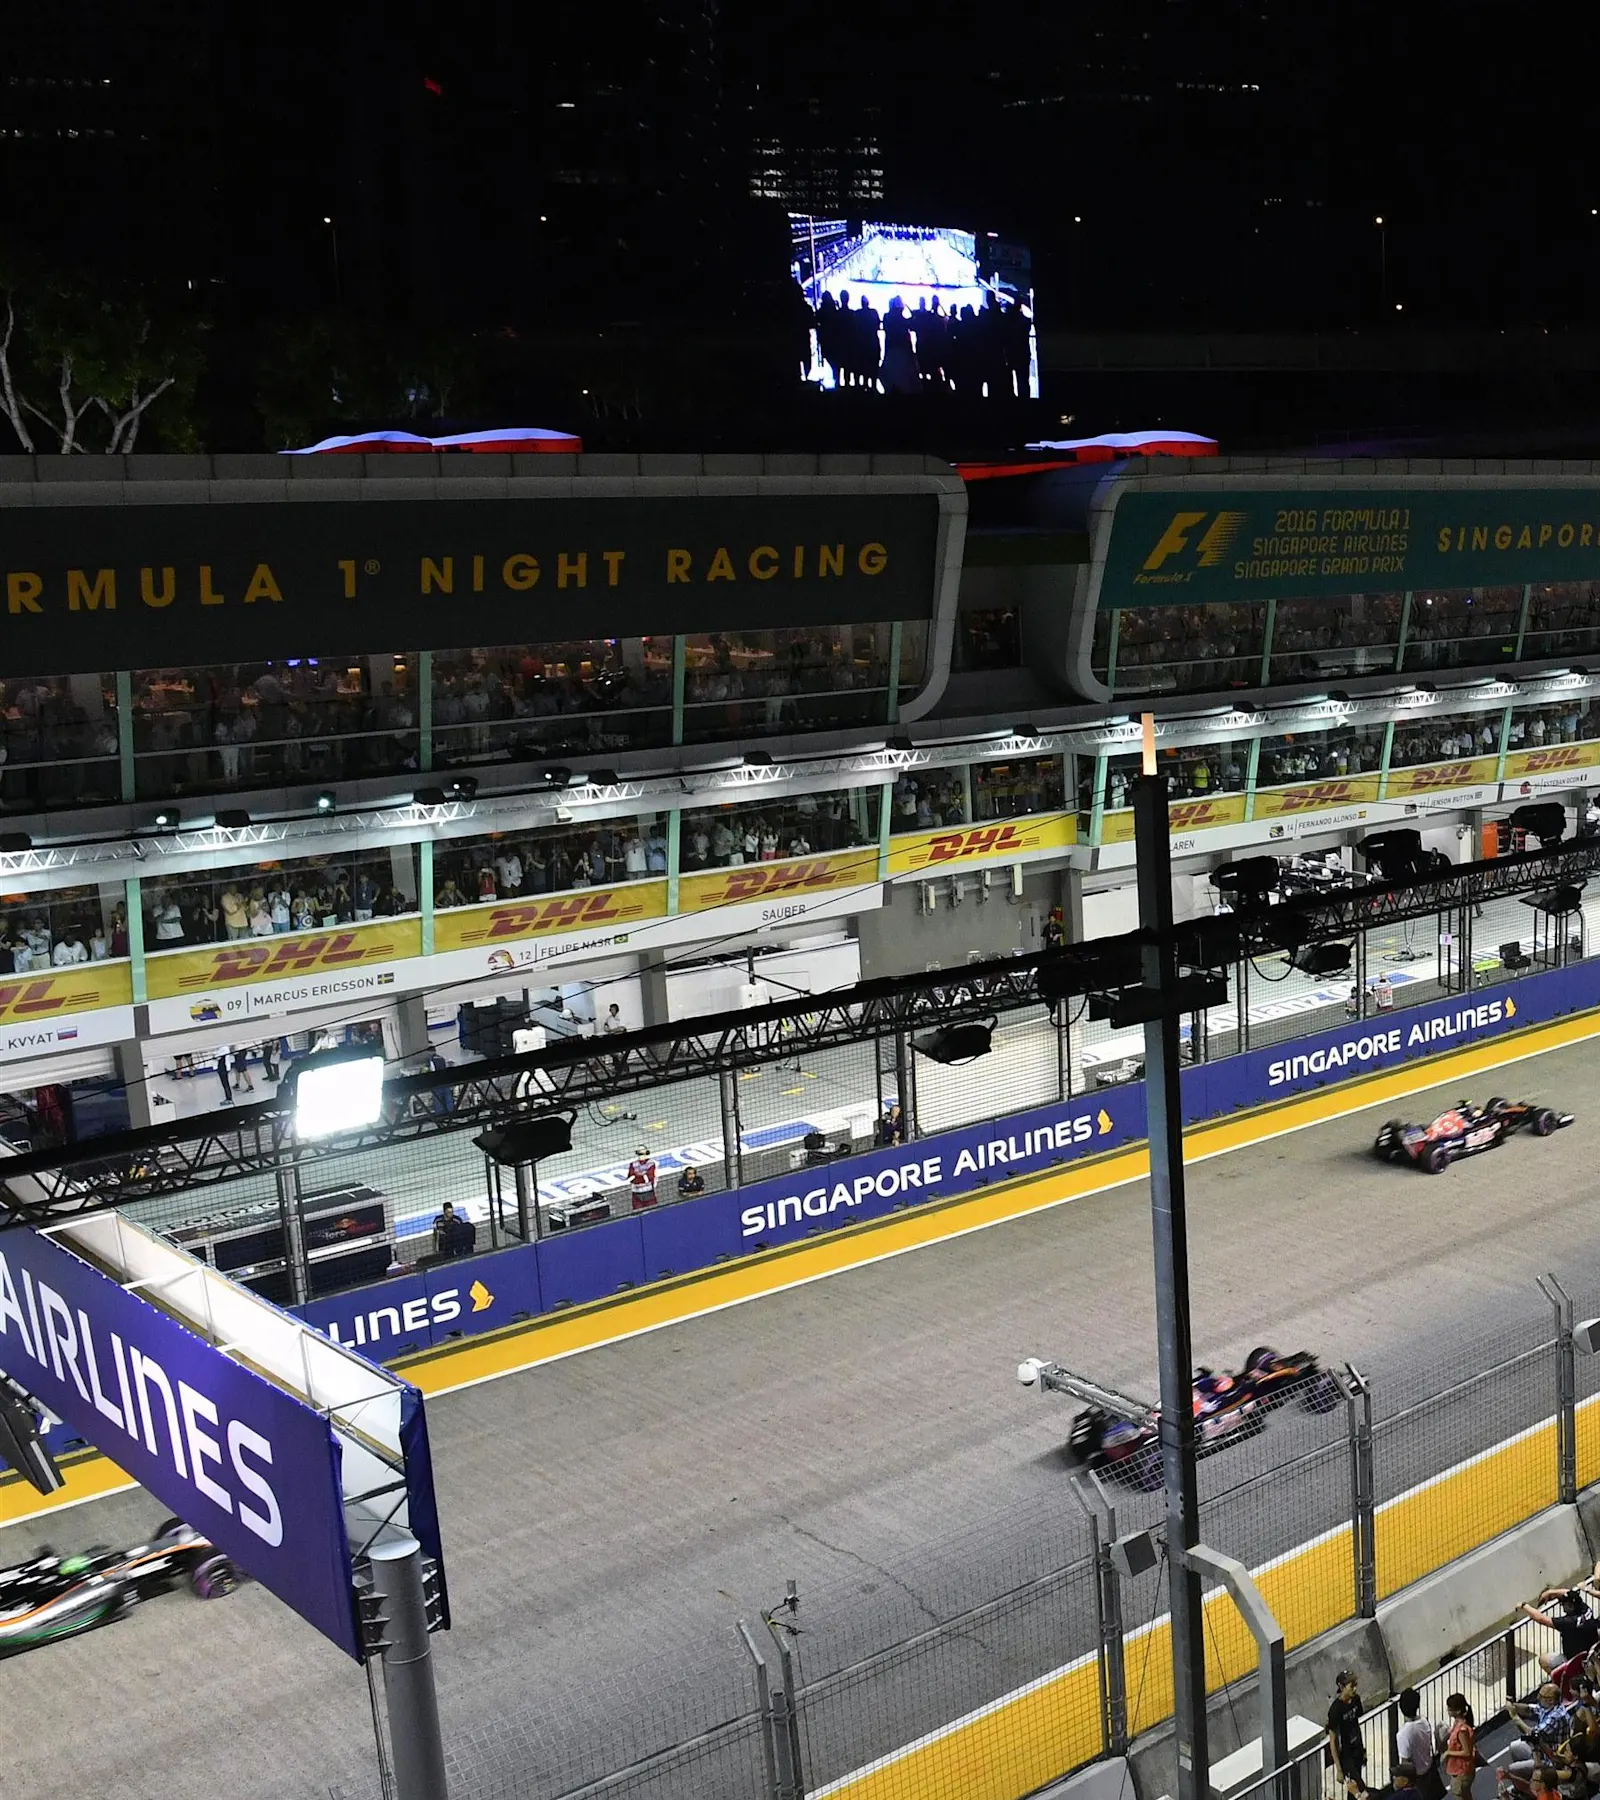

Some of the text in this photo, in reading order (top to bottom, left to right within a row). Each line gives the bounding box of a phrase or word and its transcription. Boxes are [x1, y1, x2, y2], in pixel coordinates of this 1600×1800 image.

[1274, 510, 1317, 532] 2016
[1322, 509, 1400, 531] FORMULA
[1253, 534, 1408, 555] SINGAPORE AIRLINES
[8, 563, 284, 614] RMULA
[420, 551, 625, 595] NIGHT
[666, 542, 888, 584] RACING
[1234, 556, 1405, 579] SINGAPORE GRAND PRIX
[1523, 748, 1580, 774] DHL
[1410, 764, 1472, 791] DHL
[1281, 781, 1353, 811] DHL
[1298, 816, 1332, 830] FERNANDO
[1332, 812, 1357, 824] ALONSO
[927, 826, 1024, 862] DHL
[725, 861, 840, 900] DHL
[488, 893, 622, 939] DHL
[761, 904, 806, 921] SAUBER
[210, 933, 366, 983] DHL
[520, 951, 531, 961] 12
[541, 942, 579, 957] FELIPE
[227, 977, 374, 1011] 09 MARCUS ERICSSON
[8, 1032, 53, 1049] KVYAT
[1268, 1000, 1503, 1087] SINGAPORE AIRLINES
[740, 1114, 1093, 1237] SINGAPORE AIRLINES
[328, 1288, 462, 1349] LINES
[0, 1250, 284, 1548] AIRLINES
